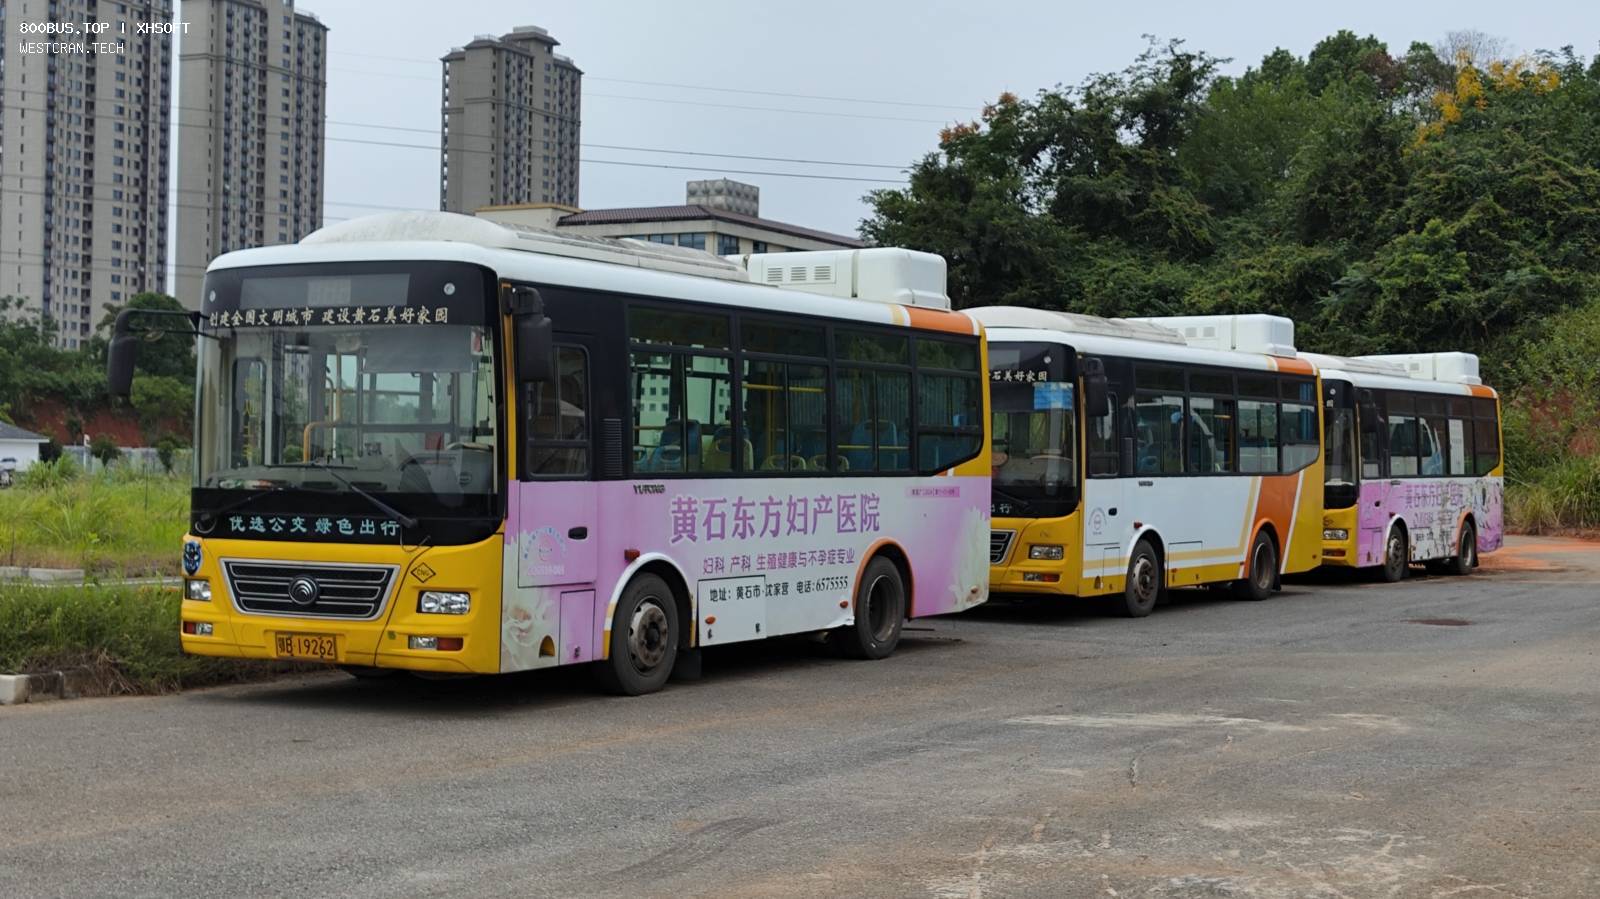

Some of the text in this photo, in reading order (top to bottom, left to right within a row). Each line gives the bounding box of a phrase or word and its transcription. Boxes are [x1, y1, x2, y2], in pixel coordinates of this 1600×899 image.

[209, 306, 449, 327] 创建全国文明城市 建设黄石美好家园
[988, 369, 1048, 383] 石美好家园
[228, 516, 400, 537] 优选公交 绿色出行
[670, 493, 881, 544] 黄石东方妇产医院
[703, 547, 856, 575] 妇科 产科 生殖健康与不孕症专业
